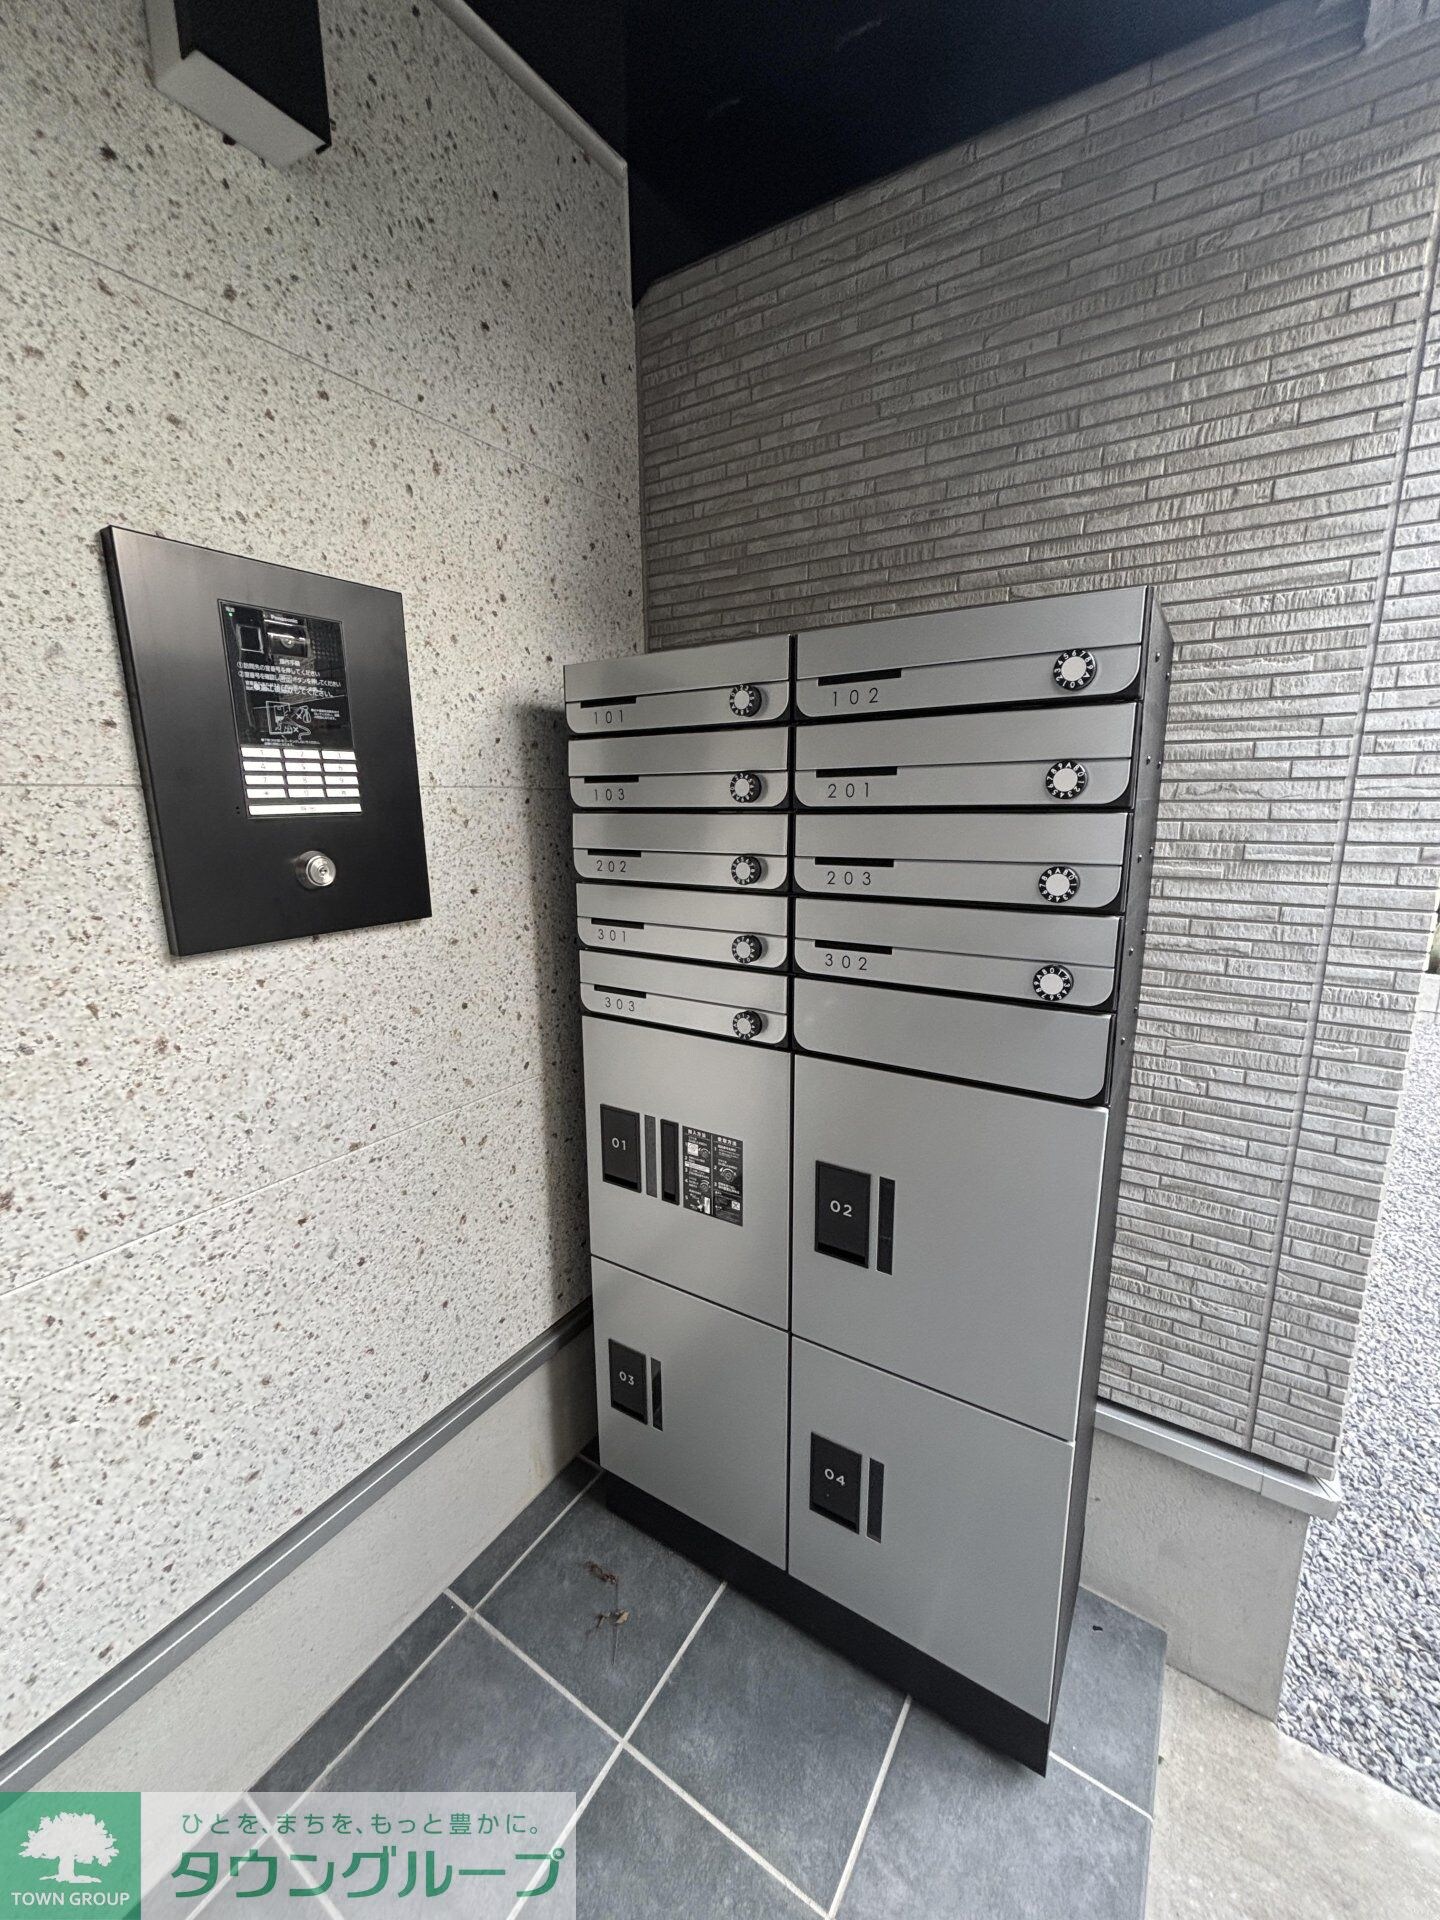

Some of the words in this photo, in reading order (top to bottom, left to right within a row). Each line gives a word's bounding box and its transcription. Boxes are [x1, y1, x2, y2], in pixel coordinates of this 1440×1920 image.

[833, 687, 879, 707] 102
[594, 709, 623, 724] 101
[594, 788, 625, 801] 103
[827, 782, 869, 798] 201
[596, 860, 627, 873] 202
[827, 870, 872, 885] 203
[598, 928, 626, 943] 301
[825, 953, 868, 971] 302
[605, 996, 635, 1012] 303
[611, 1137, 626, 1151] 01
[830, 1200, 852, 1218] 02
[619, 1370, 635, 1386] 03
[824, 1468, 845, 1487] 04
